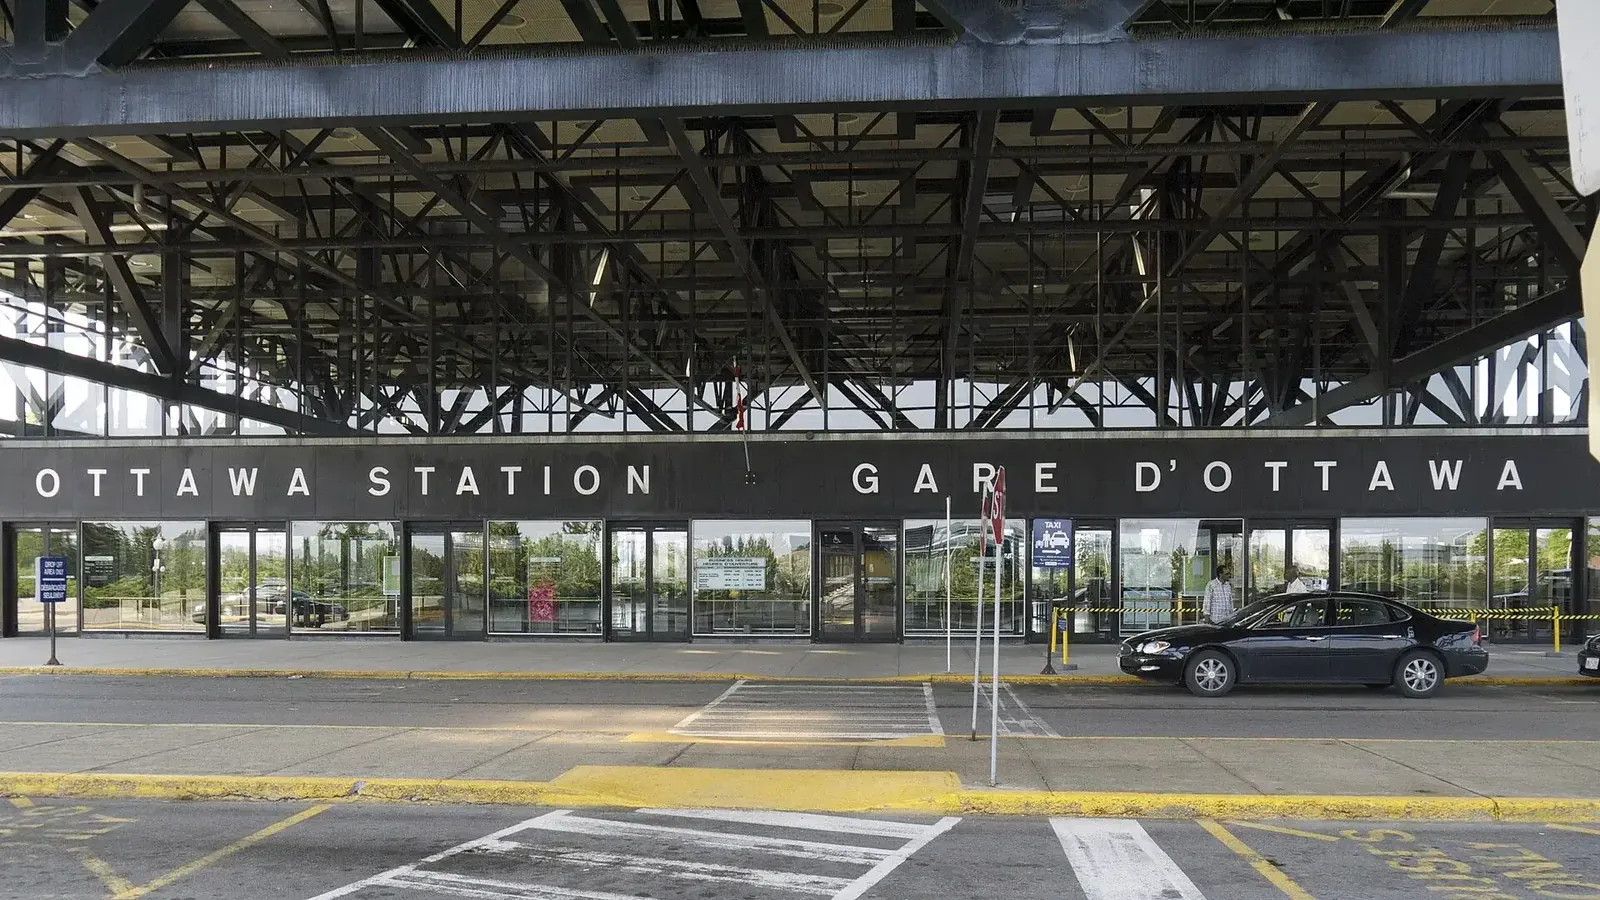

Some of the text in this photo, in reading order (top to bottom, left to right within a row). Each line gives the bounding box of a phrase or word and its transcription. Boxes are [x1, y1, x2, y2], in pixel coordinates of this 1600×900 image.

[36, 466, 650, 498] OTTAWA STATION
[853, 460, 1523, 494] GARE D'OTTAWA
[1044, 521, 1062, 529] TAXI
